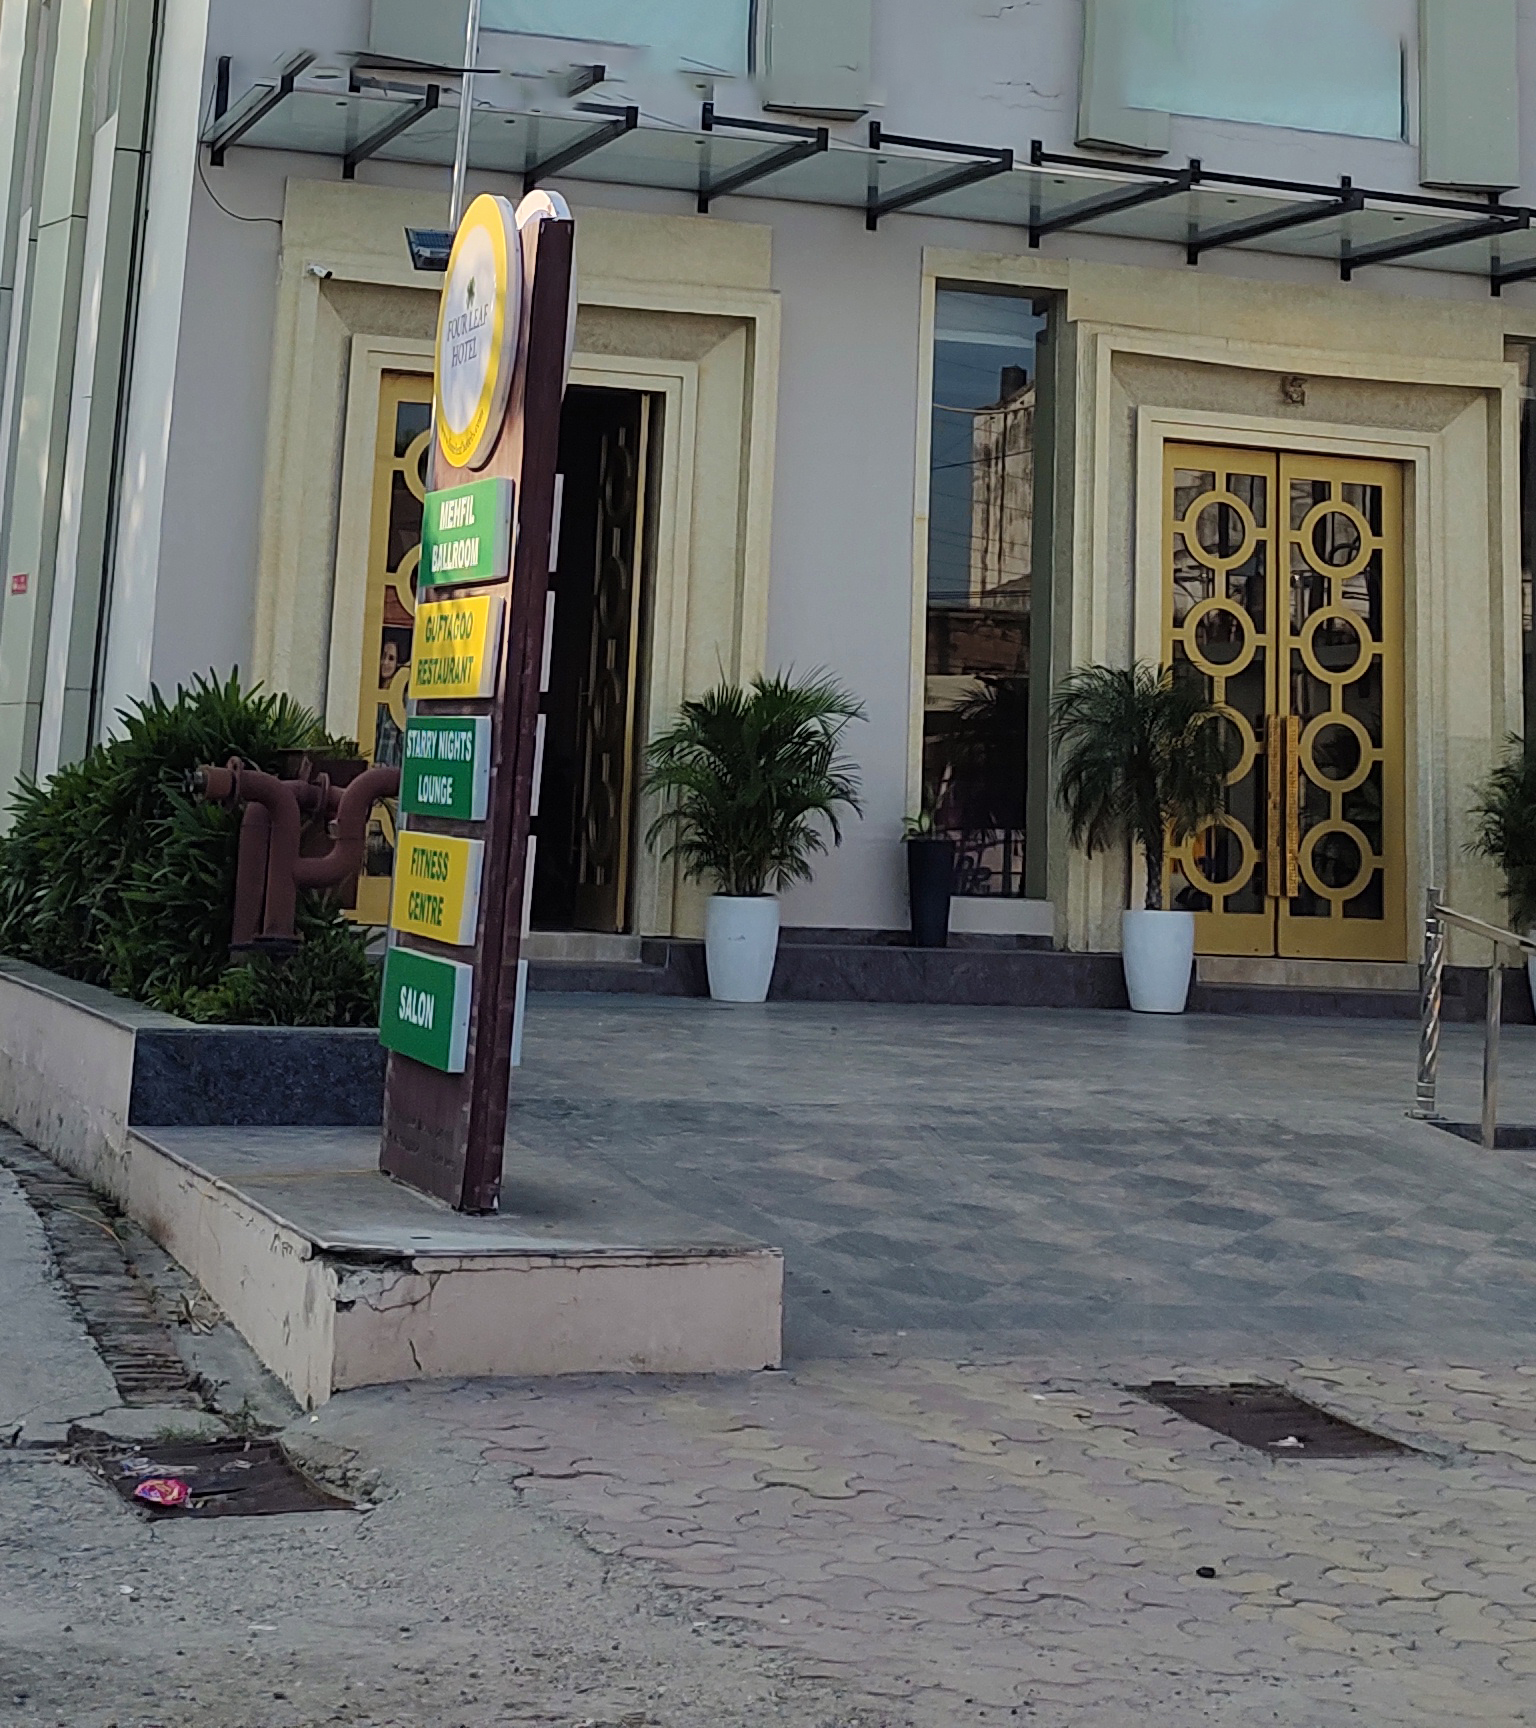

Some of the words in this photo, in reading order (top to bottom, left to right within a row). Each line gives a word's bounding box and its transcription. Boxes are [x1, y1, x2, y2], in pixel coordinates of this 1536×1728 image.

[446, 313, 468, 342] FOUR
[468, 303, 489, 332] LEAF
[451, 335, 478, 368] HOTEL
[439, 494, 475, 531] MEHFIL
[431, 536, 480, 573] BALLROOM
[425, 611, 473, 643] GUFTAGOO
[416, 655, 474, 686] RESTAURANT
[406, 729, 438, 760] STARRY
[437, 730, 473, 762] NIGHTS
[417, 774, 454, 805] LOUNGE
[410, 846, 449, 882] FITNESS
[407, 890, 444, 927] CENTRE
[398, 985, 435, 1031] SALON
